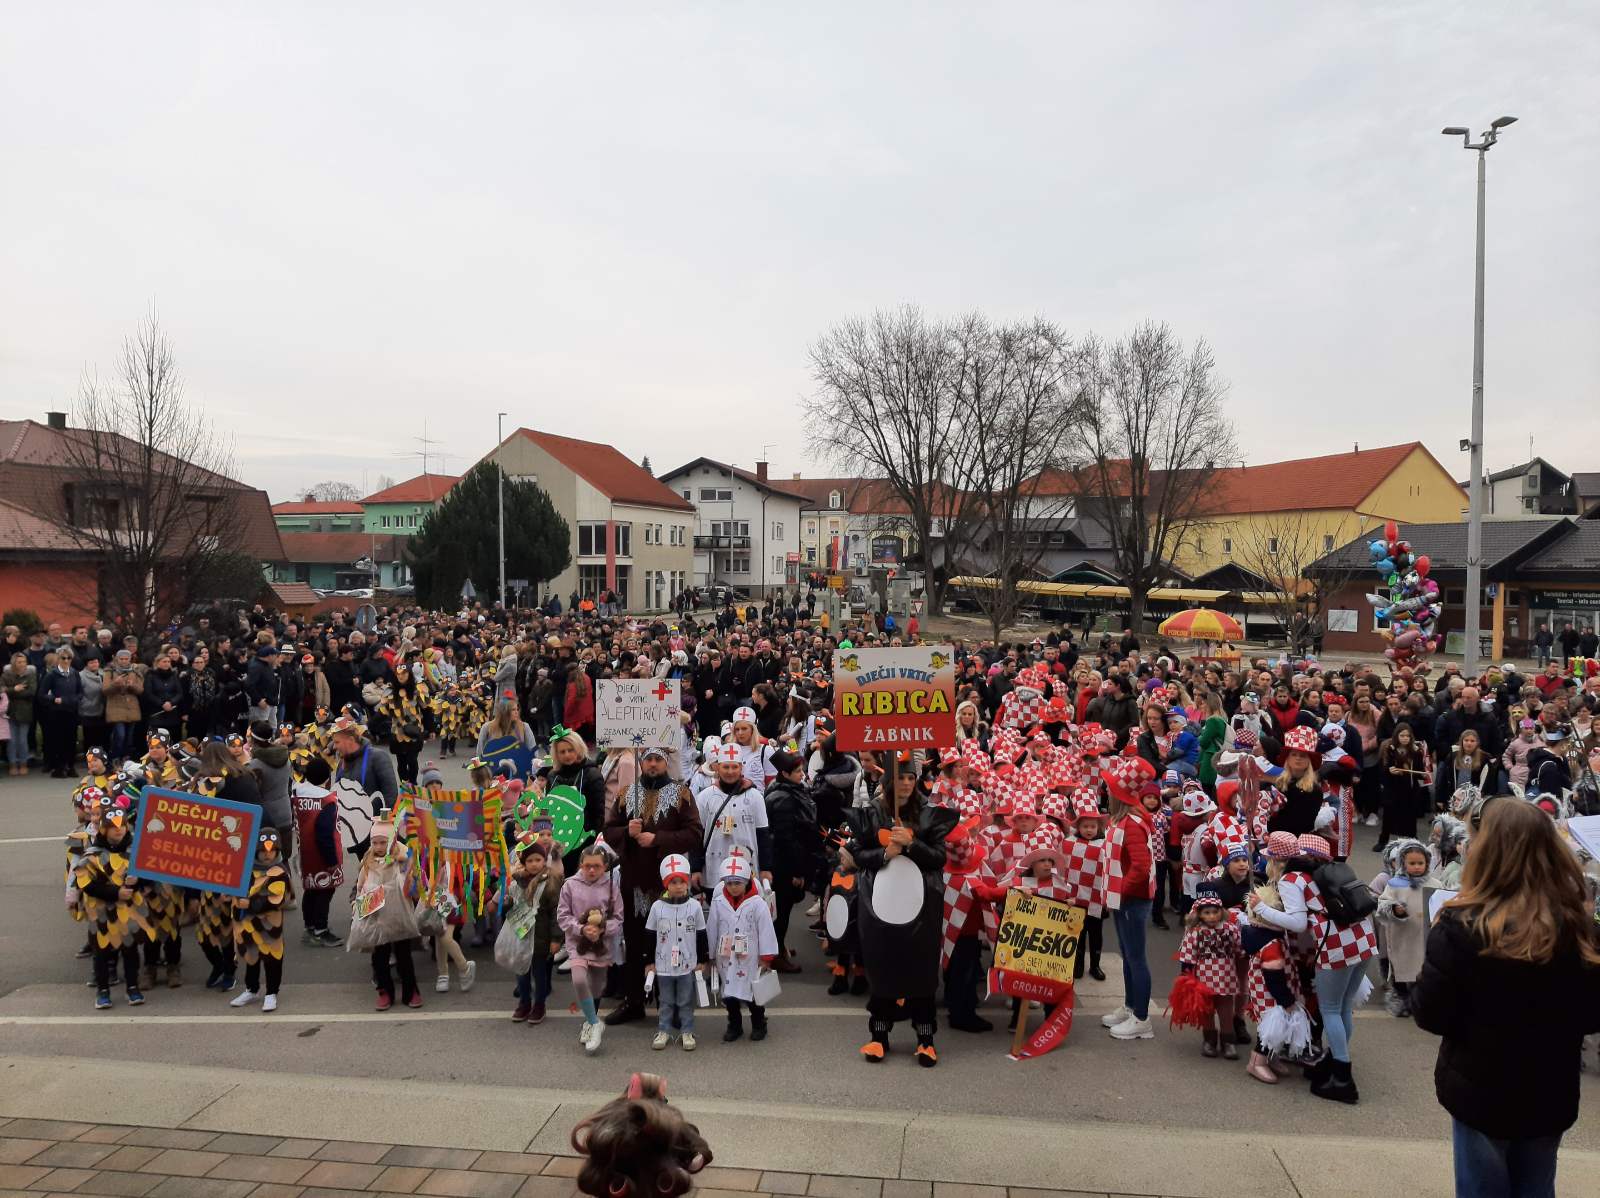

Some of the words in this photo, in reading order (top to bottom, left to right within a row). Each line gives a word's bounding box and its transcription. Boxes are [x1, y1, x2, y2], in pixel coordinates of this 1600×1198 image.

[856, 665, 896, 686] DJEČJI
[899, 667, 937, 684] VRTIĆ
[842, 689, 950, 717] RIBICA
[863, 725, 935, 743] ŽABNIK
[156, 799, 218, 823] DJEČJI
[170, 820, 223, 841] VRTIĆ
[151, 838, 232, 865] SELNIČKI
[145, 855, 232, 884] ZVONČIĆI
[1012, 980, 1054, 998] CROATIA
[1034, 1007, 1073, 1049] CROATIA
